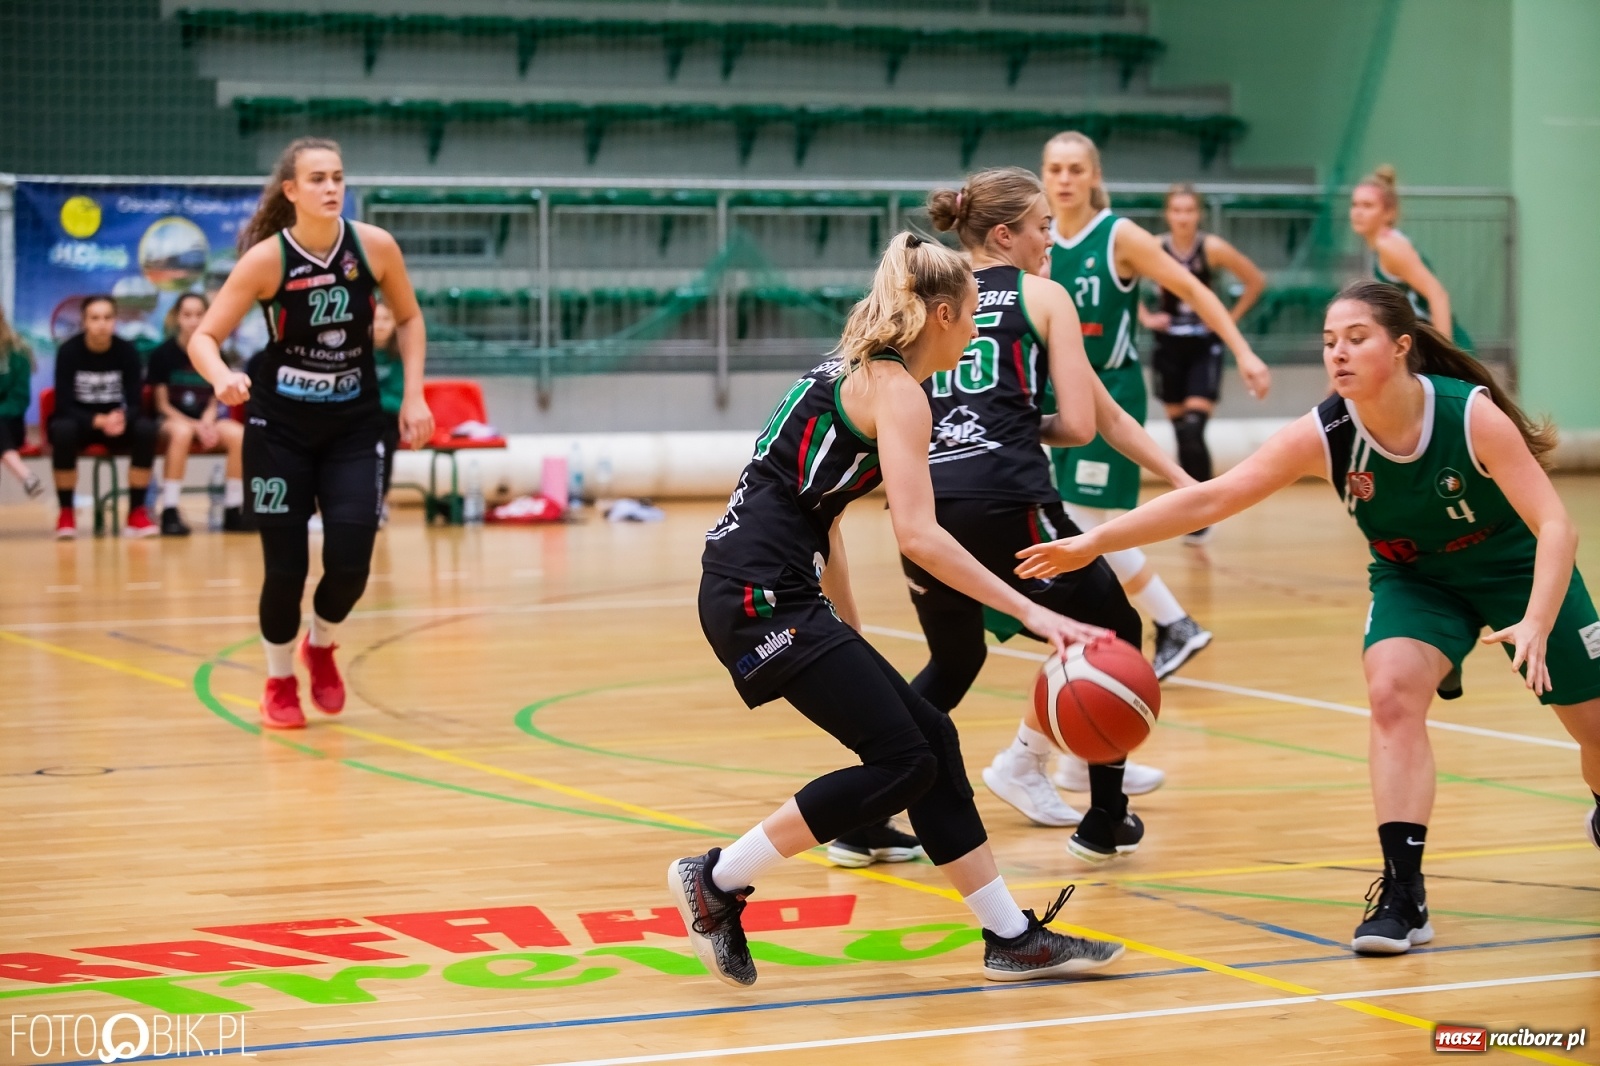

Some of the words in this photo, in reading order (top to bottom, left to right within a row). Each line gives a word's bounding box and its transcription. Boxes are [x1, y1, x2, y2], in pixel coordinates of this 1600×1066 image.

[308, 286, 354, 326] 22
[250, 476, 289, 514] 22
[1446, 499, 1476, 523] 4
[754, 628, 795, 660] Haldex
